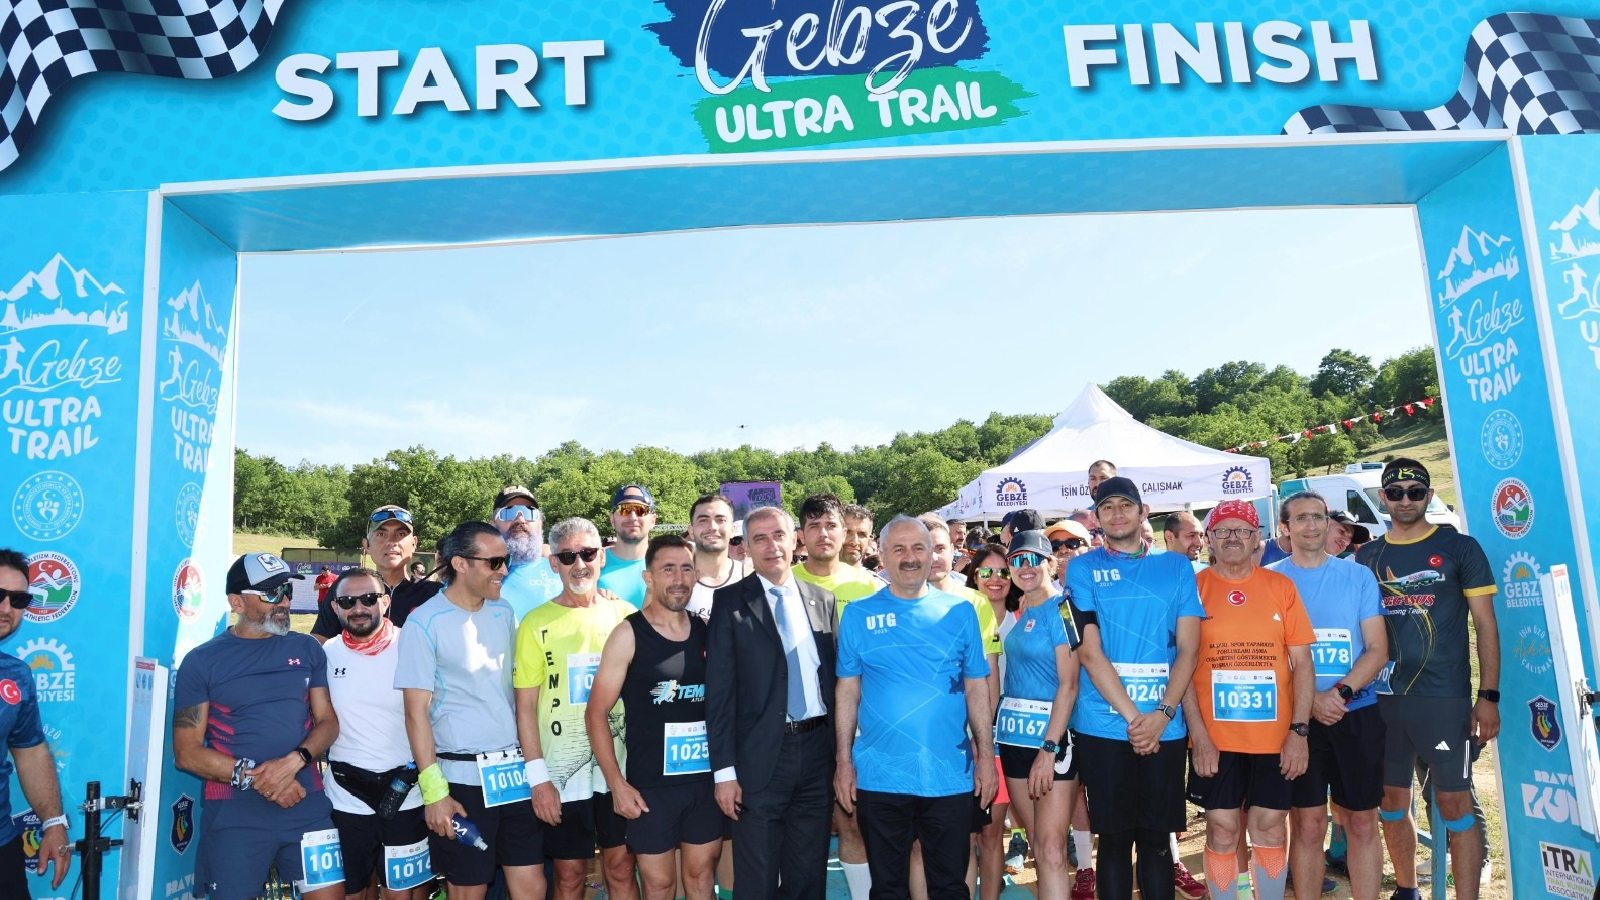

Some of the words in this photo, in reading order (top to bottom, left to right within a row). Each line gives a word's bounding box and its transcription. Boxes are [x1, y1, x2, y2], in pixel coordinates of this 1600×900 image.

[694, 0, 973, 96] Gebze
[1062, 19, 1379, 88] FINISH
[271, 39, 605, 121] START
[714, 94, 854, 143] ULTRA
[867, 81, 997, 128] TRAIL
[1466, 291, 1523, 344] Gebze
[25, 339, 121, 389] Gebze
[1459, 337, 1518, 377] ULTRA
[183, 359, 220, 415] Gebz
[1467, 365, 1521, 404] TRAIL
[2, 396, 102, 427] ULTRA
[7, 424, 99, 460] TRAIL
[1079, 485, 1090, 496] ÖZ
[1222, 480, 1252, 489] GEBZE
[996, 493, 1027, 501] GEBZE
[1093, 568, 1121, 582] UTG
[1506, 597, 1544, 608] BELEDİYES
[866, 612, 897, 630] UTG
[1521, 658, 1553, 675] ÇALIŞMA
[33, 672, 75, 690] BZE
[36, 690, 75, 702] DİYESİ
[1126, 683, 1167, 702] 0240
[1218, 690, 1272, 708] 10331
[1001, 715, 1047, 737] 10167
[670, 741, 710, 761] 1025
[310, 850, 343, 872] 101
[1544, 868, 1595, 888] INTERNATIONAL
